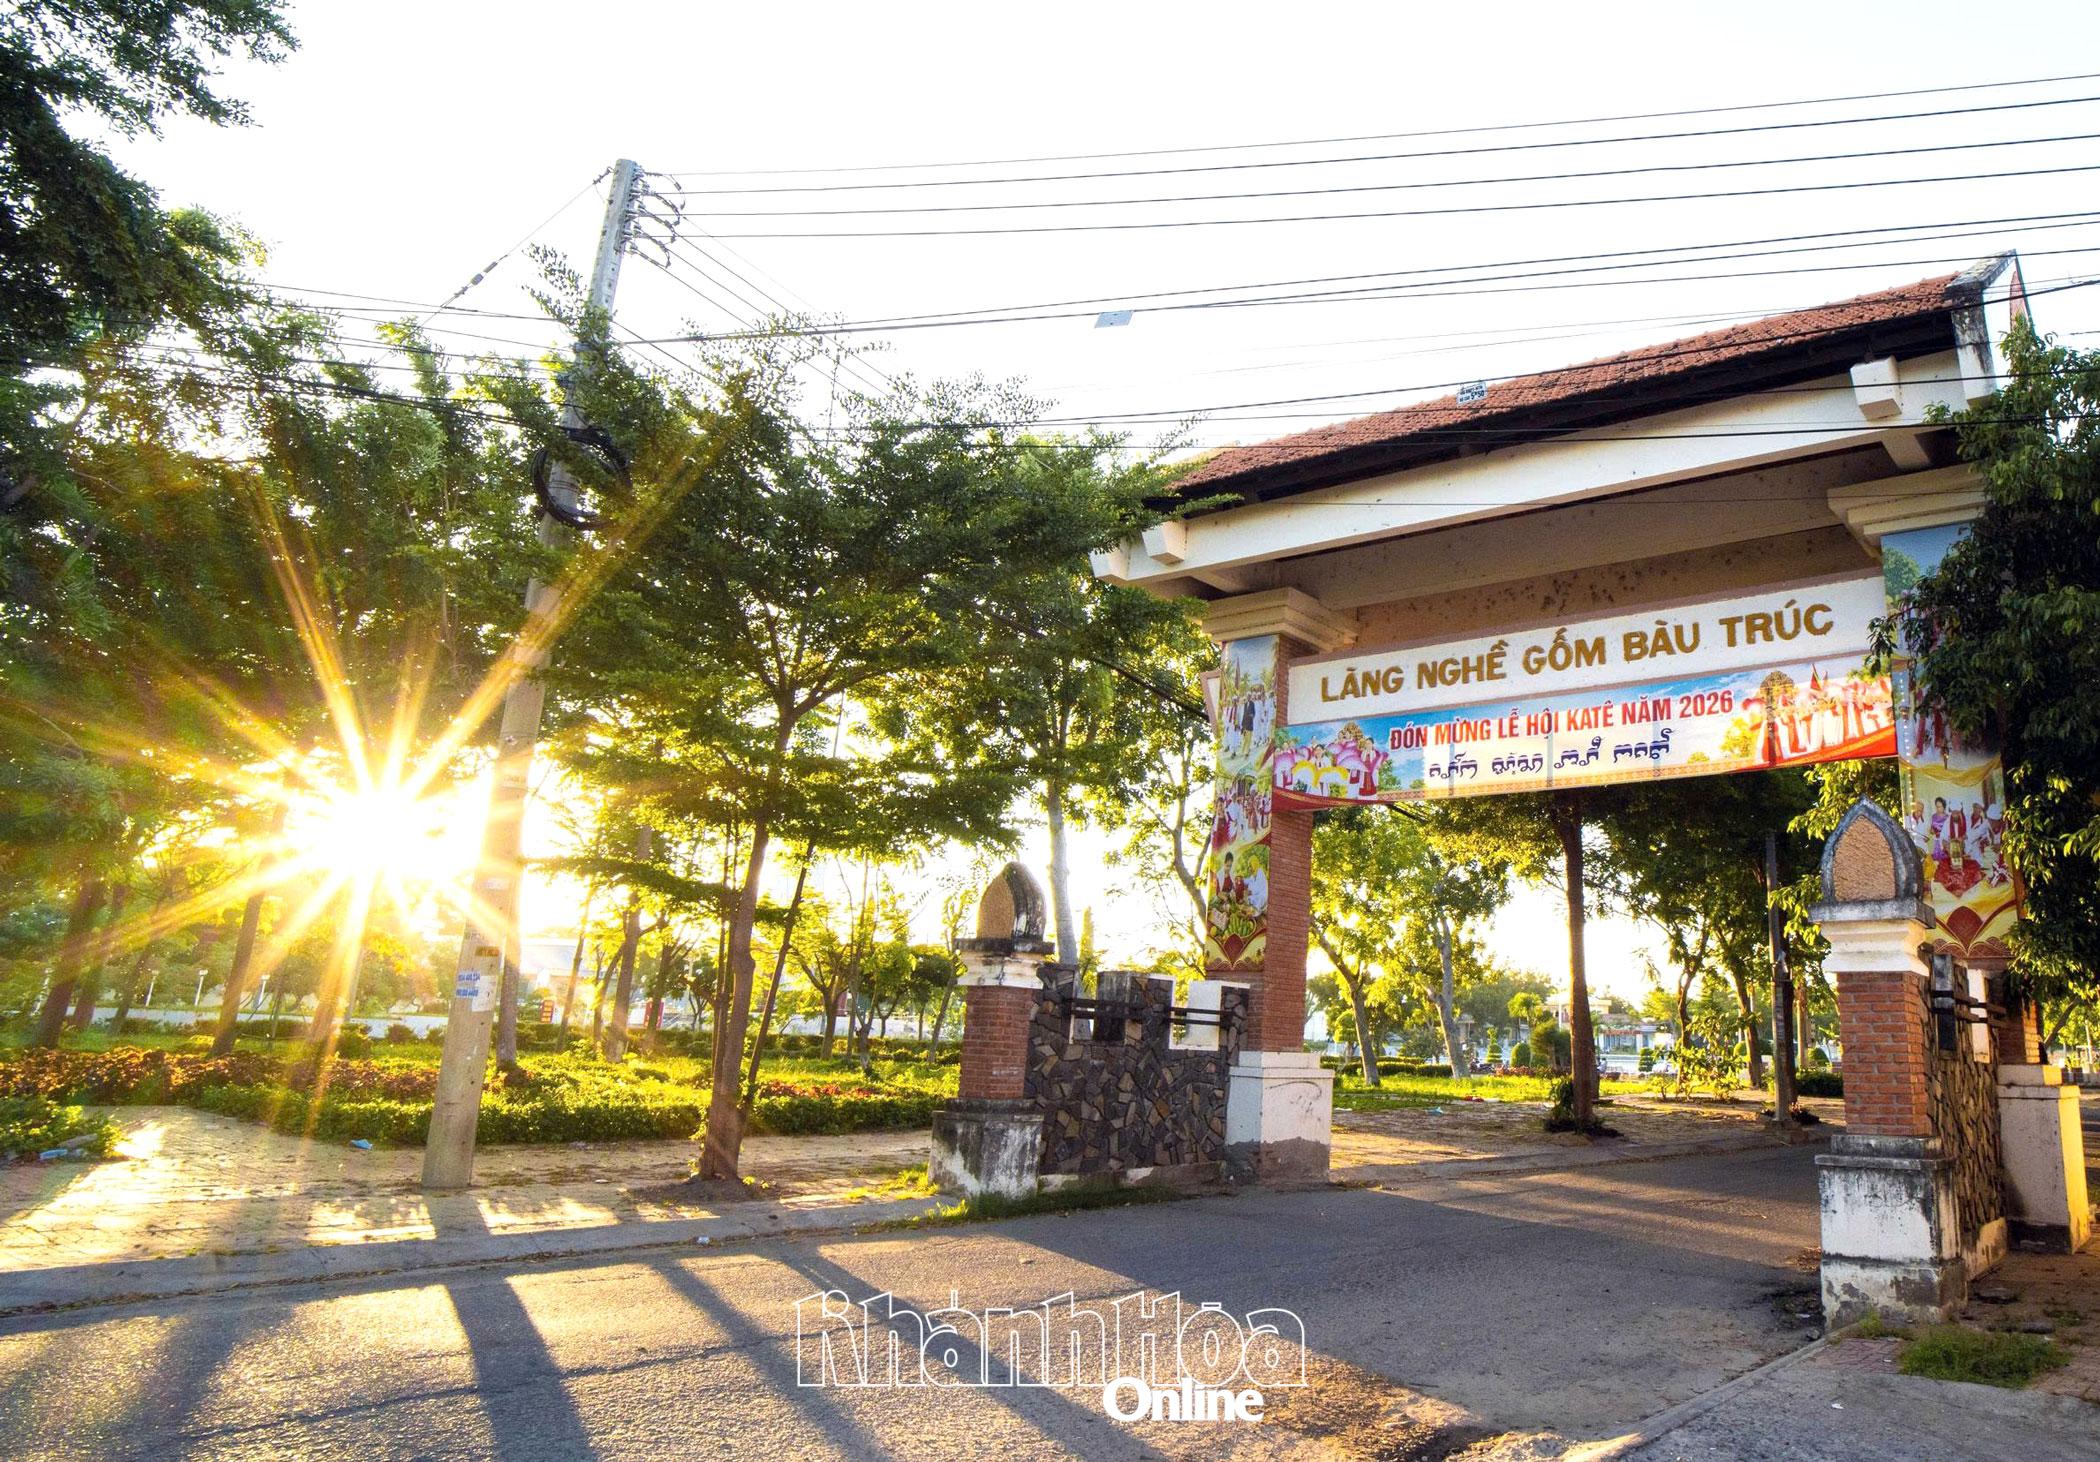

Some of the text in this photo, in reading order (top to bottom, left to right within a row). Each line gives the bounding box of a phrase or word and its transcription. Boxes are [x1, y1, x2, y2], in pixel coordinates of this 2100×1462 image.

[1321, 599, 1834, 702] LÀNG NGHỀ GỐM BÀU TRÚC
[1390, 690, 1733, 750] ĐÓN MỪNG LỄ HỘI KATÊ NĂM 2026
